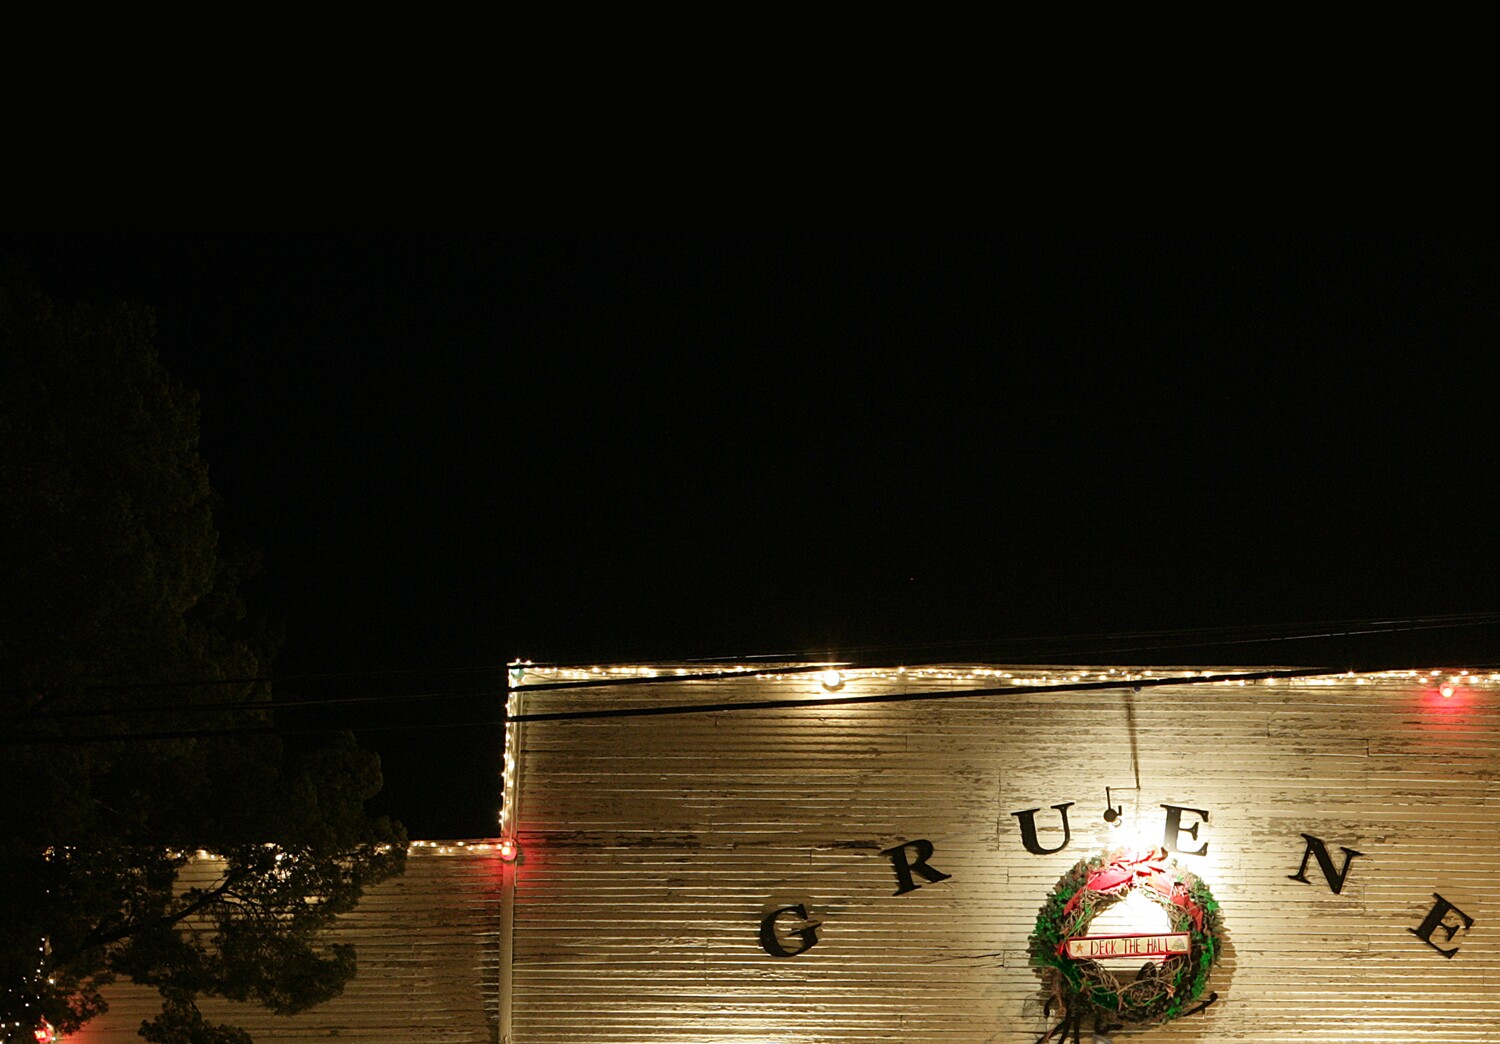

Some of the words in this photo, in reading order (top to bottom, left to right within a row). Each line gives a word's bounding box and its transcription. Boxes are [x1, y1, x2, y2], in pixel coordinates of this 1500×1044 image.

[759, 801, 1474, 960] GRUENE
[1090, 940, 1117, 955] DECK
[1122, 938, 1141, 954] THE
[1147, 938, 1171, 953] HALL
